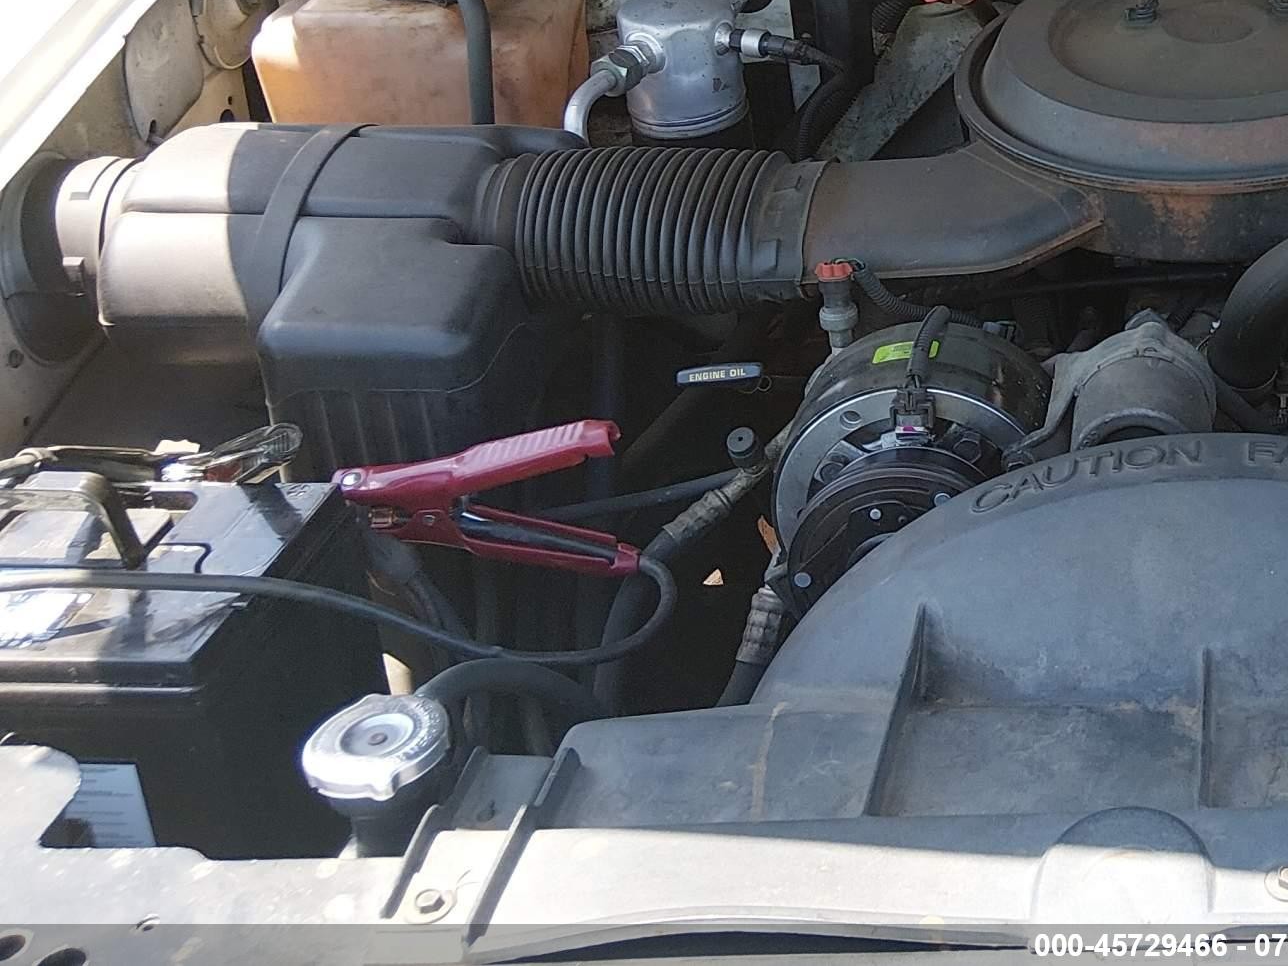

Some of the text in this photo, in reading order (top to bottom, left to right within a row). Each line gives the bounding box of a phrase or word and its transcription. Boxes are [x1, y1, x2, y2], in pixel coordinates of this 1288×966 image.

[689, 368, 746, 382] ENGINE OIL
[969, 440, 1201, 514] CAUTION
